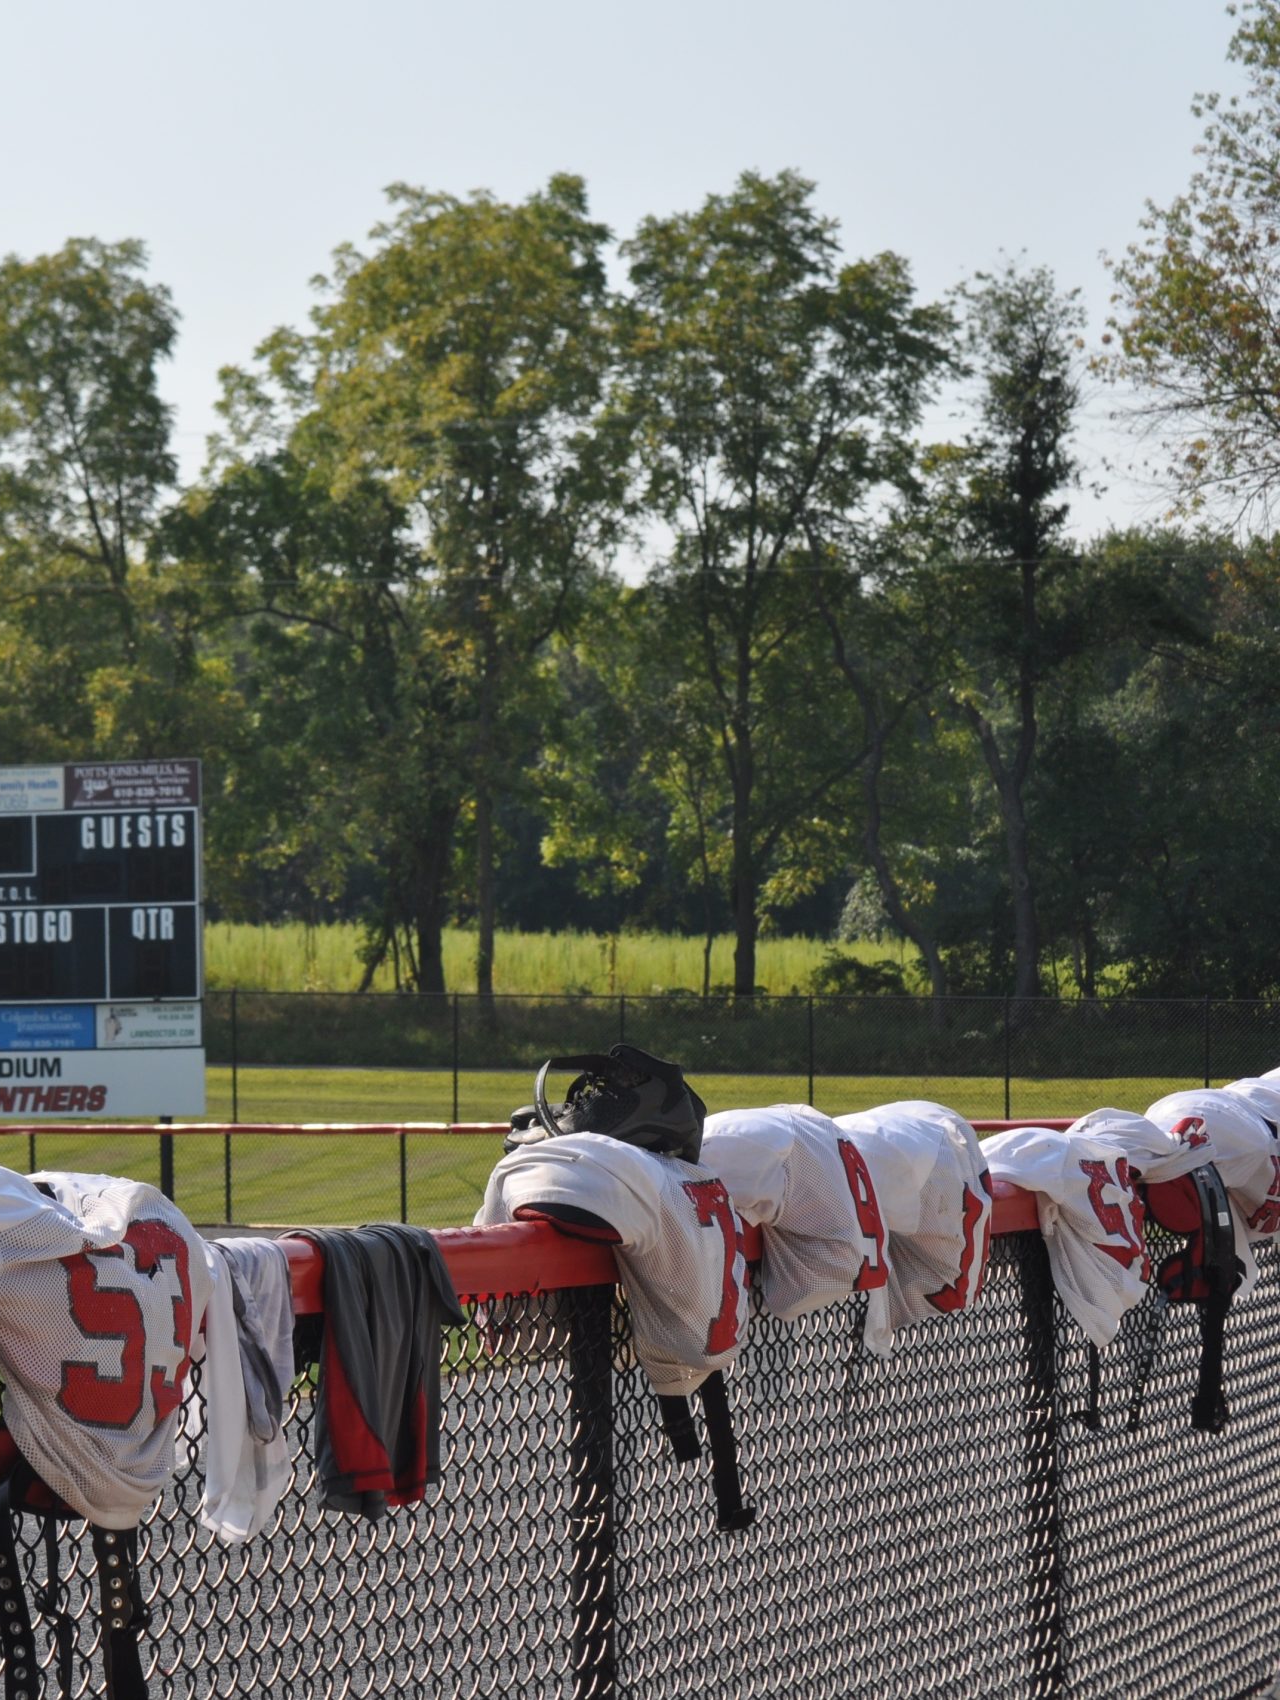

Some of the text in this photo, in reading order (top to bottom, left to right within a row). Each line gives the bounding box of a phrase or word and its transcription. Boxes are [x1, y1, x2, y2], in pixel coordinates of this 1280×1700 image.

[28, 778, 59, 789] Health
[81, 814, 186, 849] GUESTS
[11, 911, 38, 944] TO
[42, 910, 72, 942] GO
[131, 907, 175, 940] QTR
[52, 1011, 74, 1021] Gas
